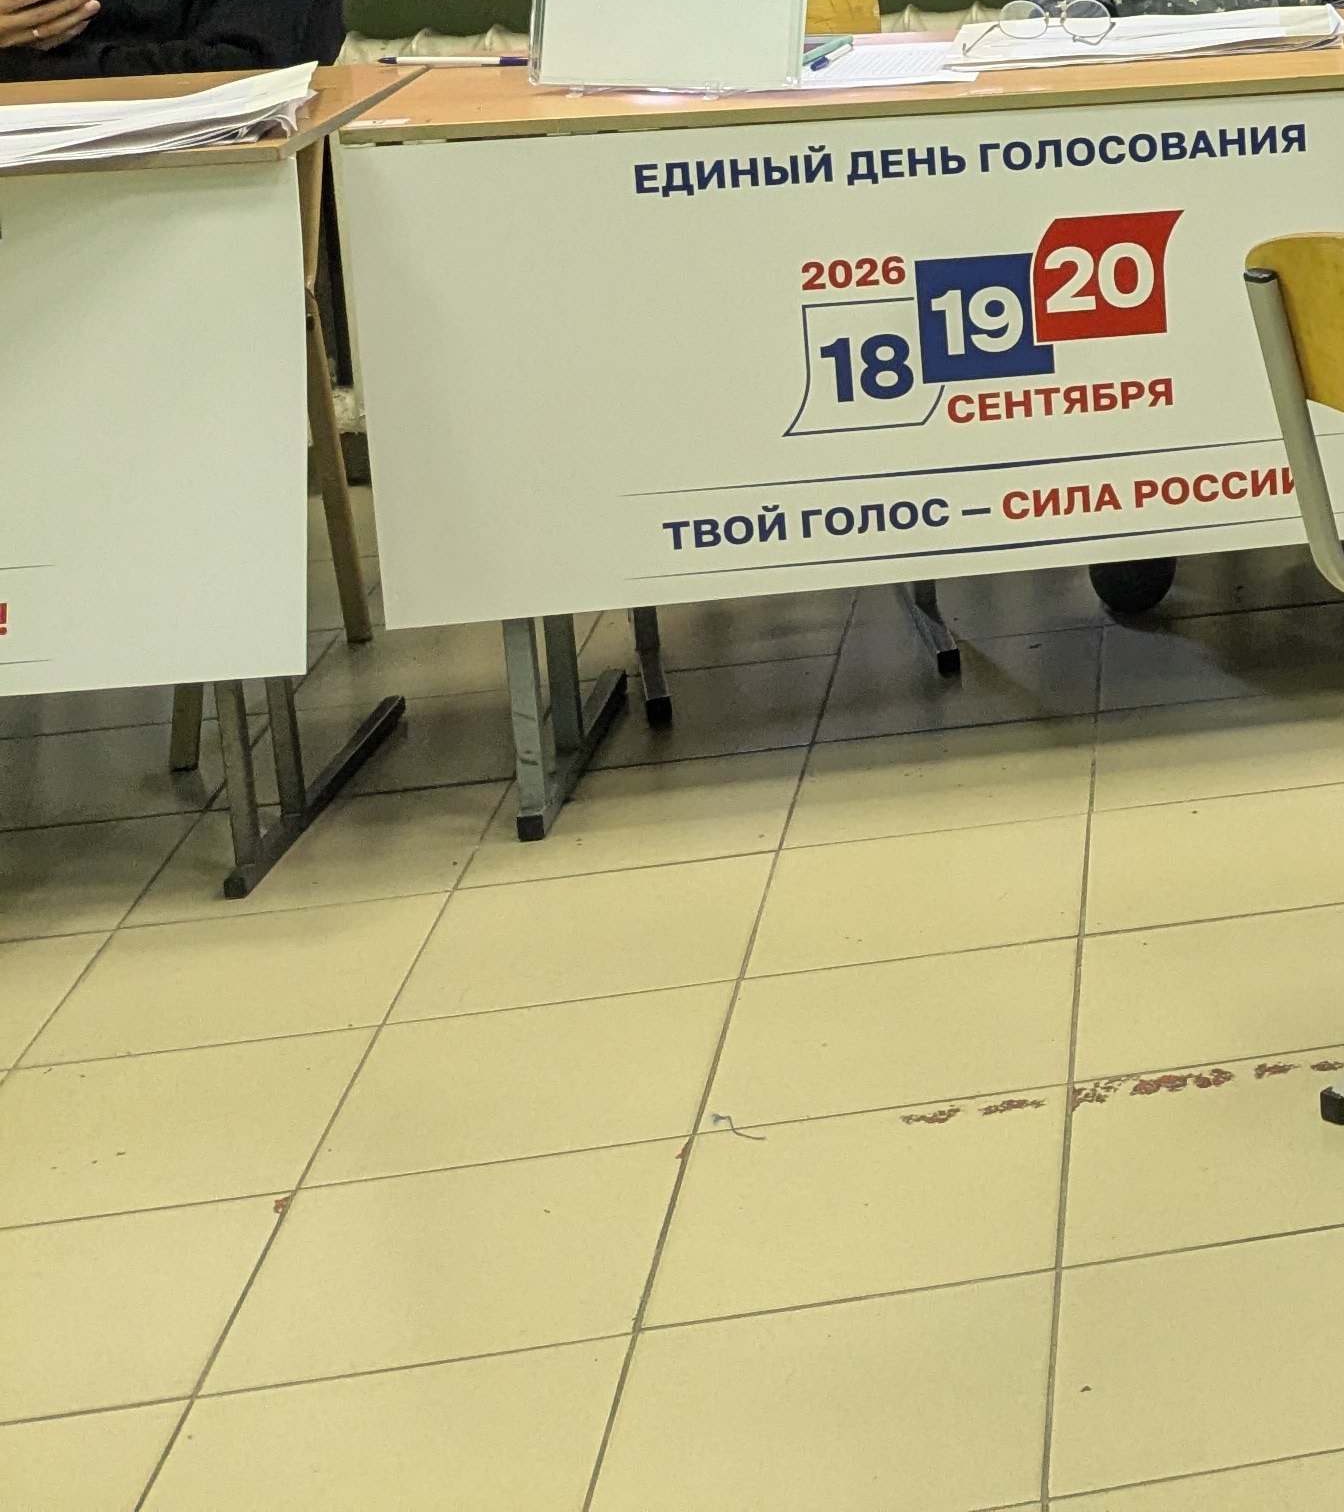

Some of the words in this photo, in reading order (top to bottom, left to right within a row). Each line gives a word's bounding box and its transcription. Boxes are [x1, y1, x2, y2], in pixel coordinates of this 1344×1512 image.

[634, 145, 834, 198] ЕДИНЫЙ
[845, 142, 968, 186] ДЕНЬ
[979, 123, 1309, 173] ГОЛОСОВАНИЯ
[801, 255, 907, 291] 2026
[1044, 242, 1156, 313] 20
[930, 286, 1024, 356] 19
[820, 334, 915, 403] 18
[946, 377, 1176, 425] СЕНТЯБРЯ
[663, 508, 788, 552] ТВОЙ
[801, 496, 952, 540] ГОЛОС
[1002, 483, 1124, 522] СИЛА
